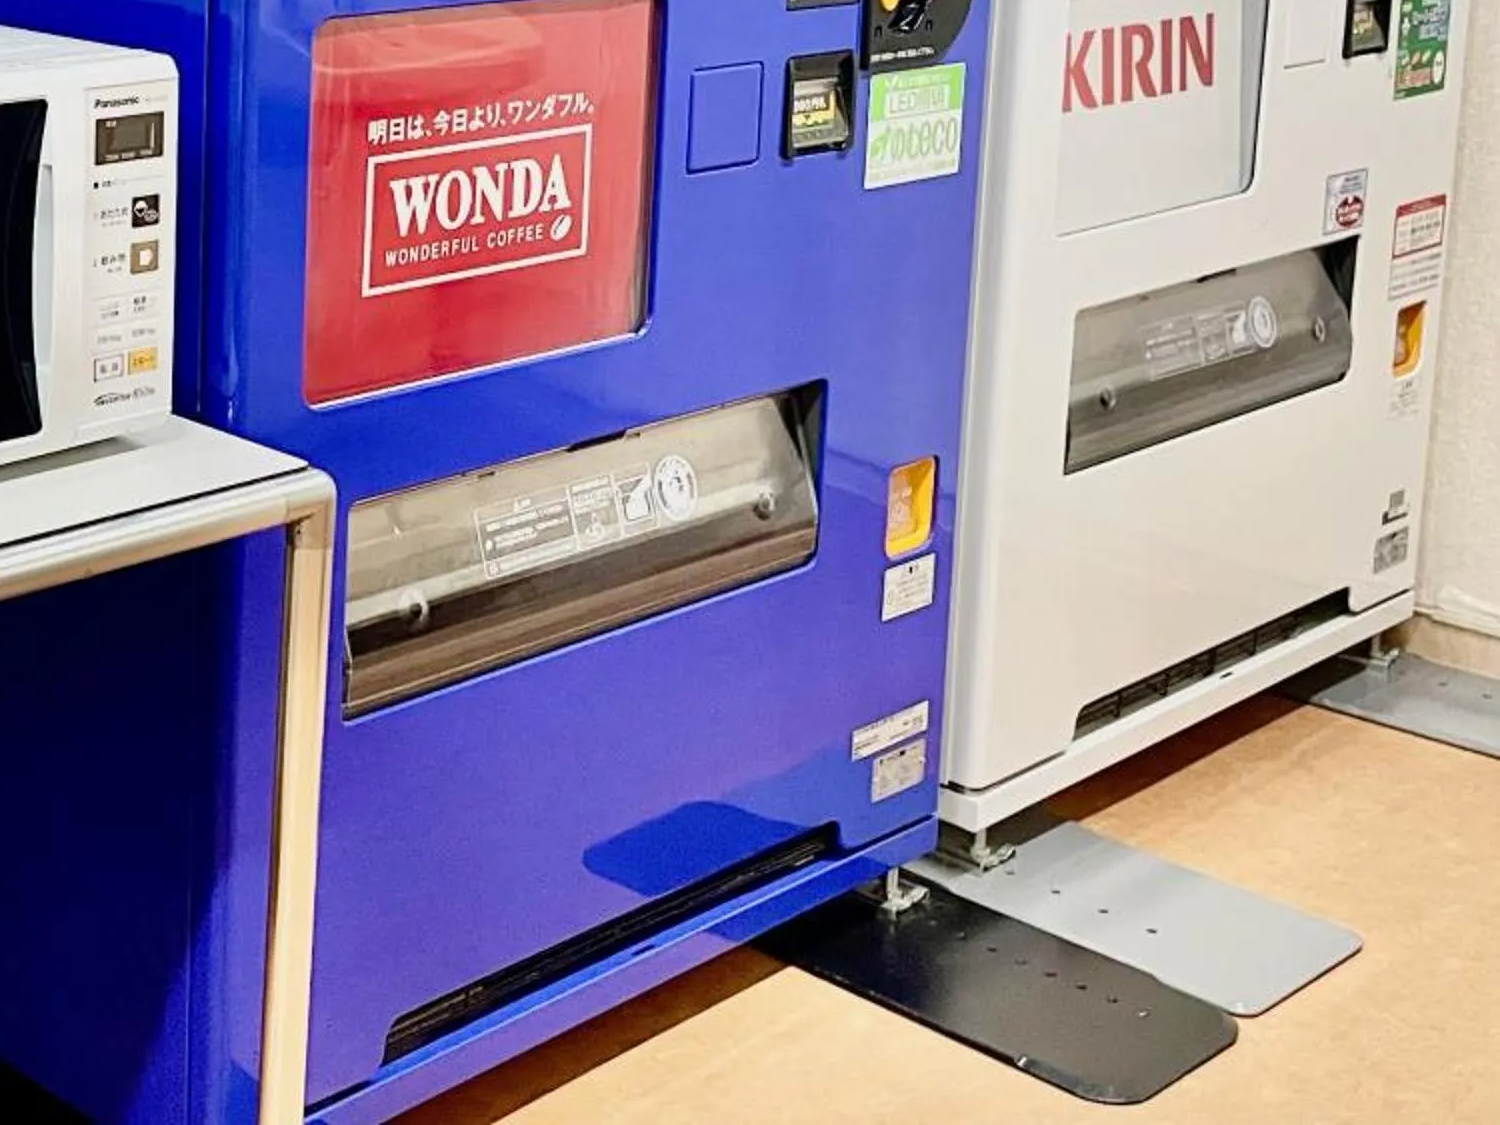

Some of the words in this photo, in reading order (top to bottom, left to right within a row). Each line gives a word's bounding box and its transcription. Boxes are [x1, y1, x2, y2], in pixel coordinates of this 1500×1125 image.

[1061, 12, 1215, 113] KIRIN
[368, 92, 595, 146] 明日は、今日より、ワンダフル。
[389, 153, 572, 237] WONDA
[385, 238, 479, 267] WONDERFUL
[486, 222, 544, 249] COFFEE
